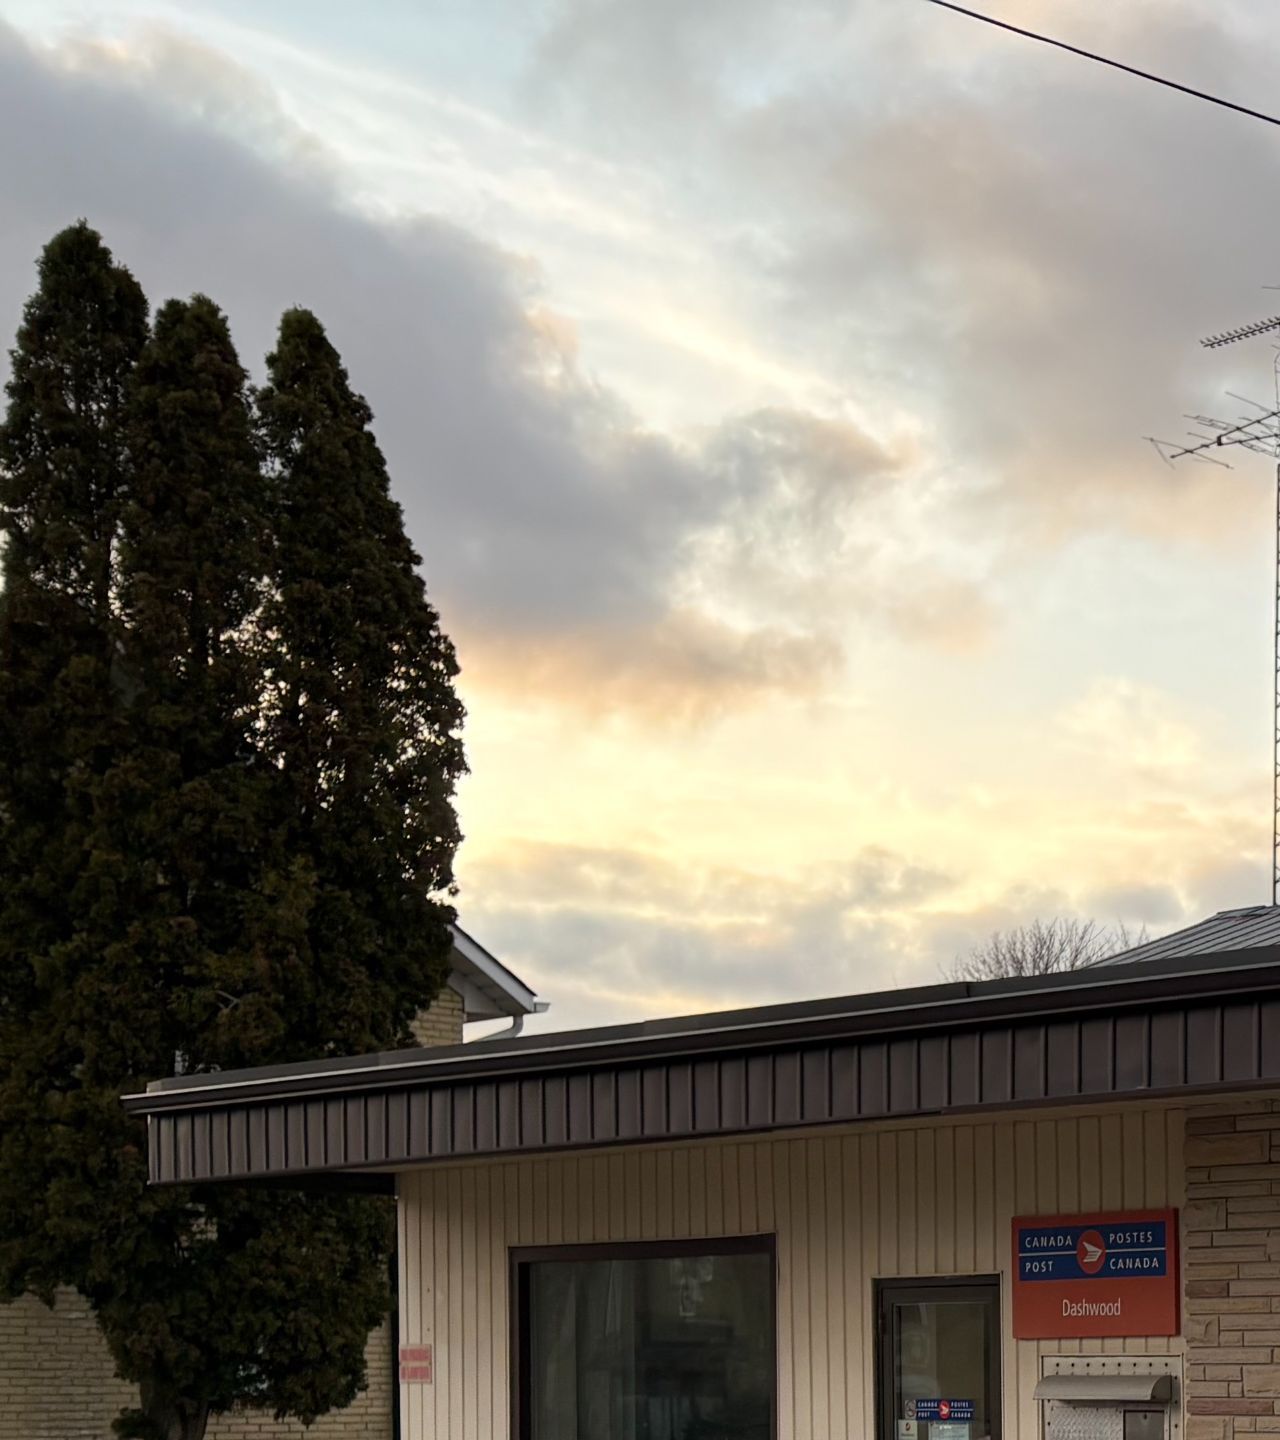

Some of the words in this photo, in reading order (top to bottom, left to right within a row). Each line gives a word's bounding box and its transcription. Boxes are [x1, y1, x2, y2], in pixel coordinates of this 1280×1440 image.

[1025, 1235, 1073, 1248] CANADA
[1109, 1231, 1153, 1244] POSTES
[1025, 1261, 1054, 1273] POST
[1109, 1257, 1159, 1270] CANADA
[1062, 1298, 1121, 1317] Dashwood
